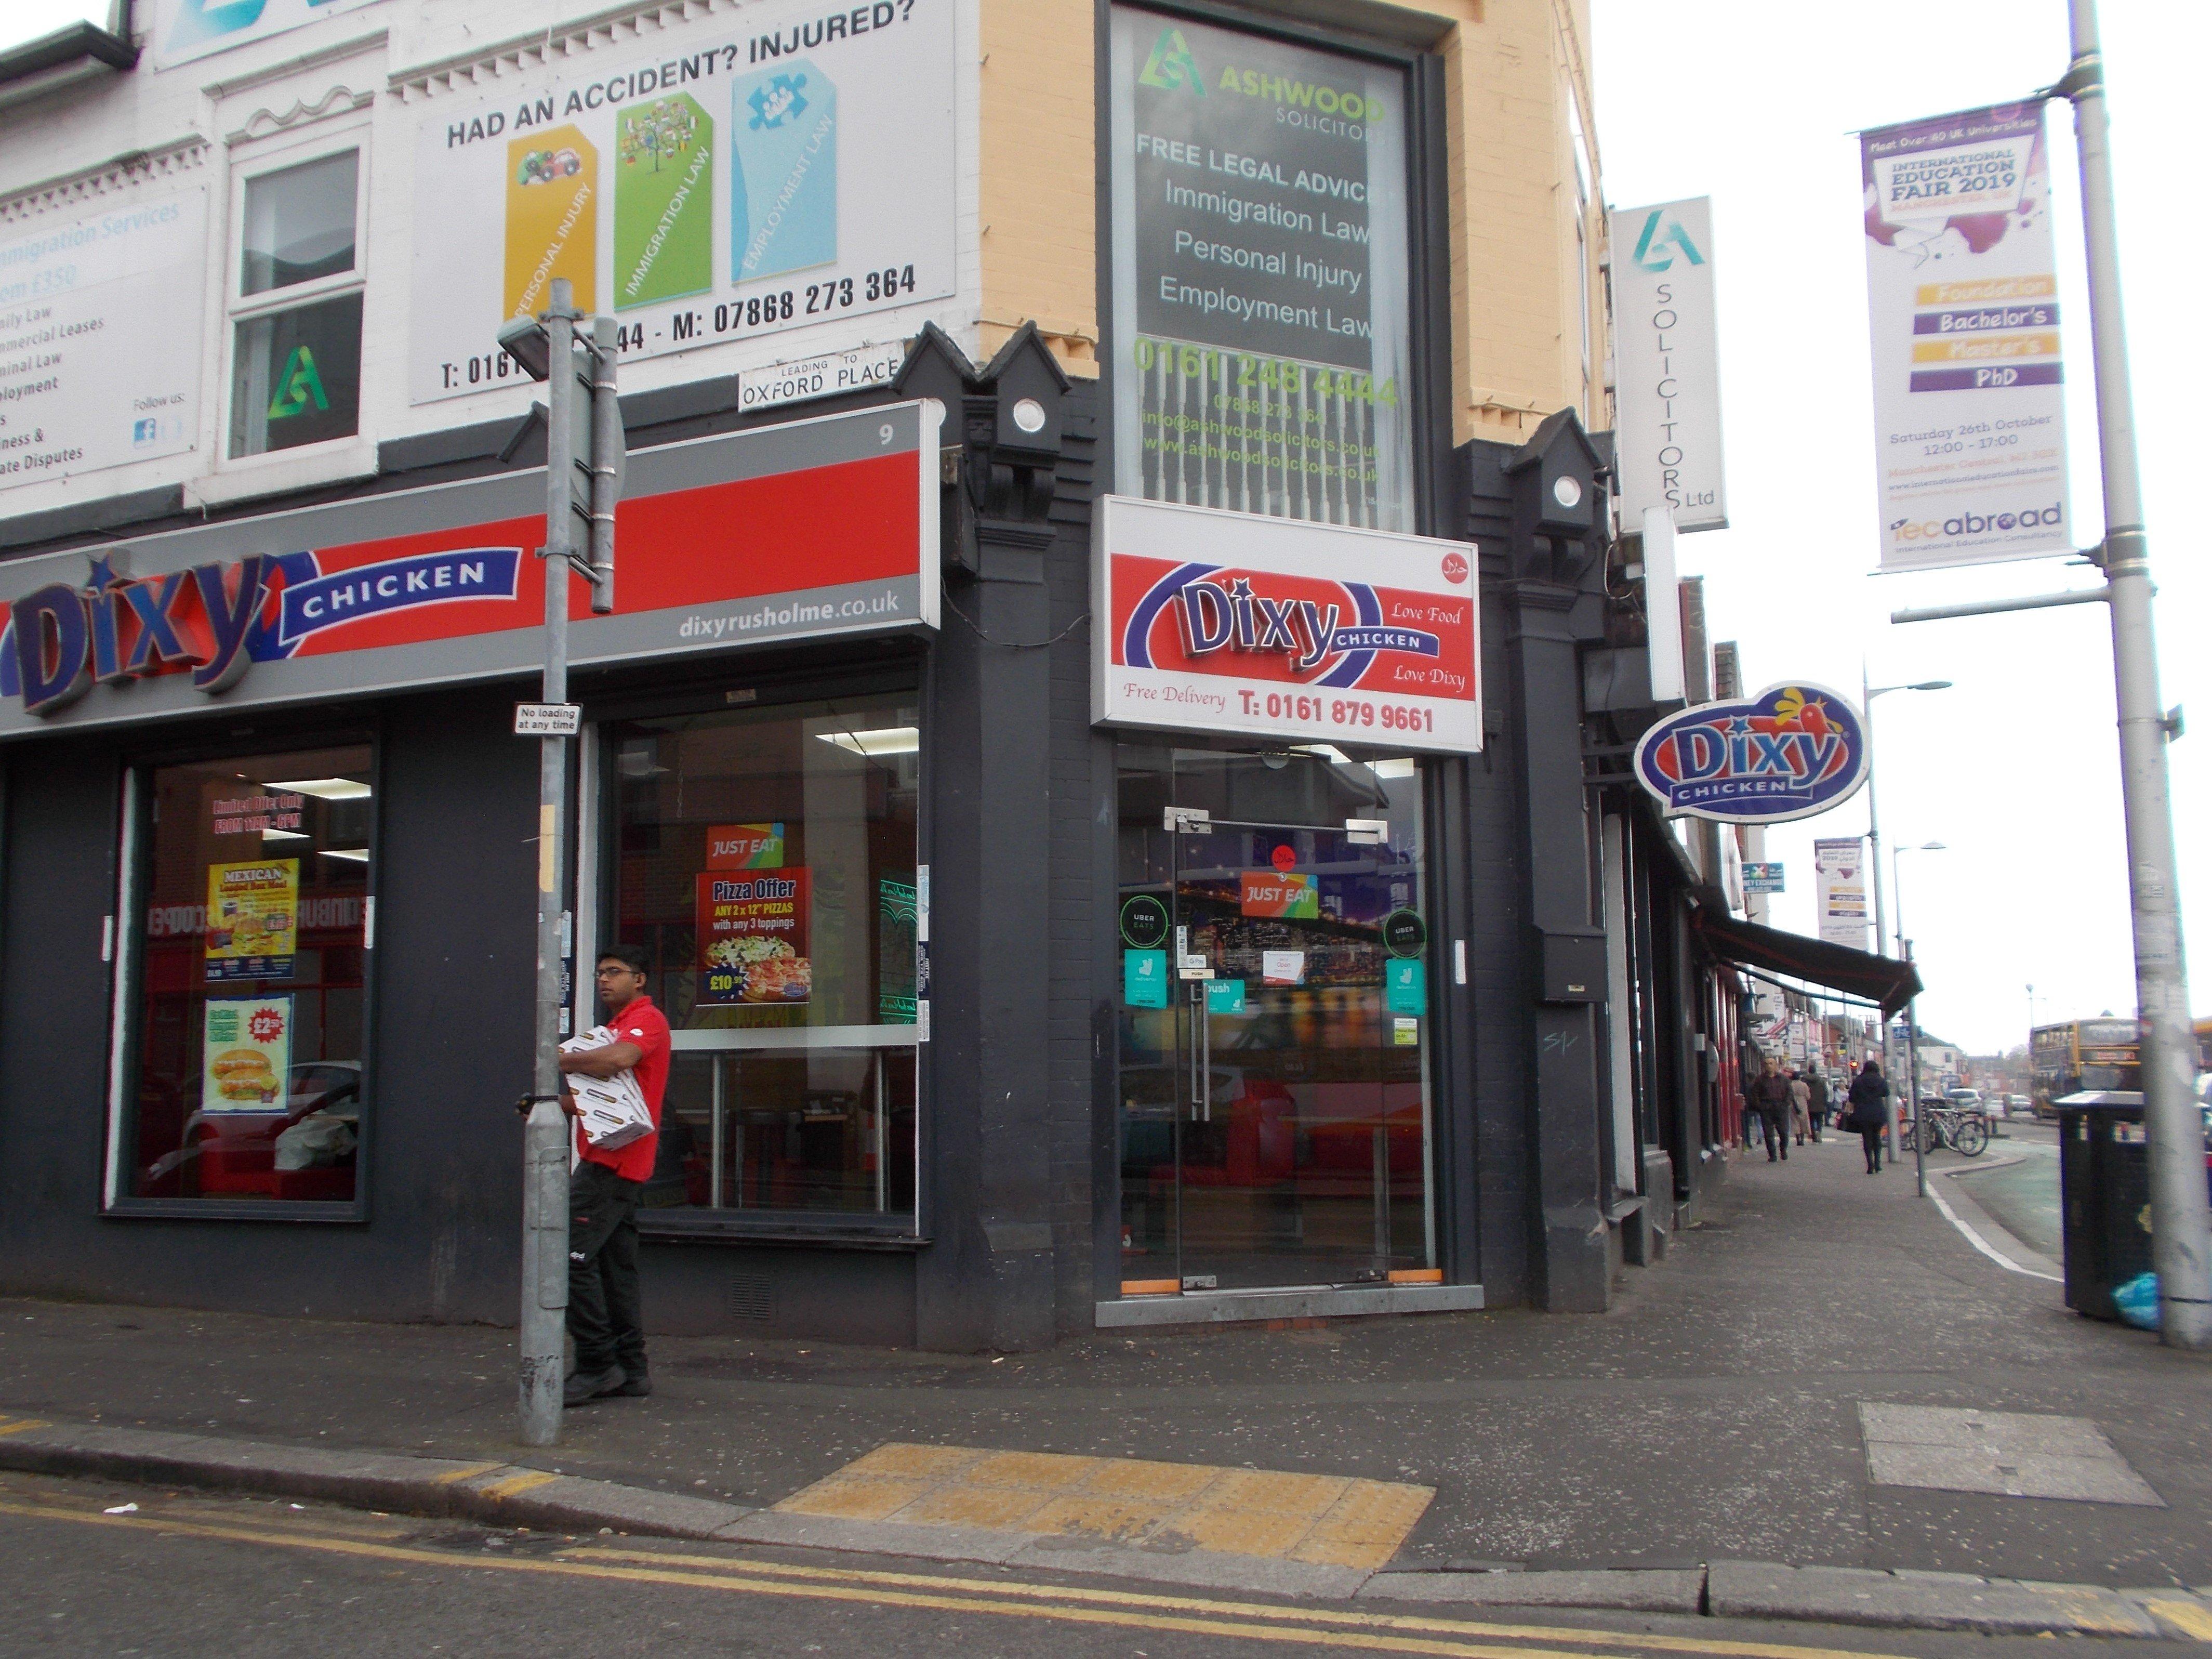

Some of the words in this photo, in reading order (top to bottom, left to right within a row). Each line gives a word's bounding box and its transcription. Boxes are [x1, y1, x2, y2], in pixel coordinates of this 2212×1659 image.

[448, 111, 505, 149] HAD
[514, 97, 554, 129] AN
[564, 45, 738, 115] ACCIDENT?
[750, 0, 915, 63] INJURED?
[1219, 64, 1384, 122] ASHWOOD
[1276, 107, 1363, 141] SOLICITO
[1871, 139, 1897, 152] Meet
[1900, 134, 1927, 147] Over
[1930, 130, 1947, 141] 40
[1950, 127, 1965, 138] UK
[1968, 118, 2037, 136] Universities
[1136, 133, 1201, 166] FREE
[1209, 150, 1289, 186] LEGAL
[1294, 169, 1366, 202] ADVIC
[1891, 159, 2016, 186] EDUCATION
[1892, 148, 2015, 172] INTERNATIONAL
[743, 153, 812, 270] EMPLOYMENT
[806, 114, 832, 154] LAW
[1890, 180, 1951, 202] FAIR
[1958, 172, 2017, 193] 2019
[625, 185, 691, 296] IMMIGRATION
[683, 146, 709, 185] LAW
[1165, 178, 1313, 232] Immigration
[1320, 212, 1371, 243] Law
[0, 227, 97, 264] mmigration
[102, 203, 180, 238] Services
[514, 242, 563, 317] PERSONAL
[557, 182, 591, 239] INJURY
[1175, 229, 1287, 275] Personal
[1295, 254, 1362, 294] Injury
[0, 281, 26, 302] om
[31, 264, 77, 295] £350
[26, 306, 52, 322] Law
[1160, 275, 1318, 330] Employment
[1326, 308, 1373, 339] Law
[1940, 307, 2048, 332] Bachelor's
[60, 317, 104, 338] Leases
[442, 362, 458, 389] T:
[672, 310, 703, 344] M:
[713, 288, 795, 333] 07868
[805, 278, 854, 314] 273
[865, 264, 916, 303] 364
[36, 352, 62, 368] Law
[781, 360, 828, 377] LEADING
[843, 354, 858, 364] TO
[1134, 336, 1221, 382] 0161
[1236, 354, 1301, 393] 248
[1313, 366, 1399, 409] 4444
[0, 375, 59, 402] loyment
[743, 374, 824, 404] OXFORD
[838, 359, 899, 387] PLACE
[1975, 368, 2019, 388] PhD
[134, 396, 167, 412] Follow
[1653, 283, 1683, 509] SOLICITORS
[34, 427, 45, 442] &
[879, 424, 893, 446] 9
[1890, 426, 1954, 444] Saturday
[1959, 422, 1991, 436] 26th
[1995, 415, 2051, 431] October
[24, 447, 83, 469] Disputes
[1924, 440, 1964, 456] 12:00
[1979, 433, 2019, 450] 17:00
[1686, 489, 1714, 507] Ltd
[679, 589, 899, 639] dixyrusholme.co.uk
[1182, 577, 1341, 669] Dixy
[1336, 633, 1420, 649] CHICKEN
[1391, 602, 1423, 620] Love
[1427, 607, 1465, 625] Food
[9, 549, 271, 717] Dixy
[303, 560, 485, 619] CHICKEN
[1393, 665, 1426, 682] Love
[1429, 668, 1466, 693] Dixy
[1123, 682, 1157, 702] Free
[1162, 686, 1226, 714] Delivery
[1238, 689, 1261, 717] T:
[1267, 693, 1322, 722] 0161
[1332, 699, 1375, 727] 879
[1381, 704, 1434, 732] 9661
[519, 720, 529, 729] at
[532, 721, 550, 730] any
[553, 720, 575, 729] time
[521, 708, 535, 717] No
[539, 708, 575, 719] loading
[1672, 715, 1841, 791] Dixy
[1678, 781, 1786, 801] CHICKEN
[712, 839, 748, 858] JUST
[750, 837, 780, 853] EAT
[223, 867, 284, 883] MEXICAN
[713, 880, 753, 902] Pizza
[754, 878, 797, 900] Offer
[1246, 886, 1283, 903] JUST
[1284, 886, 1313, 902] EAT
[714, 905, 732, 917] ANY
[733, 904, 739, 916] 2
[740, 907, 746, 916] x
[763, 902, 794, 915] PIZZAS
[1134, 914, 1155, 922] UBER
[713, 919, 732, 930] with
[733, 920, 749, 932] any
[750, 917, 757, 929] 3
[758, 916, 796, 931] toppings
[1133, 921, 1154, 930] EATS
[1395, 926, 1414, 934] UBER
[1277, 961, 1291, 970] Open
